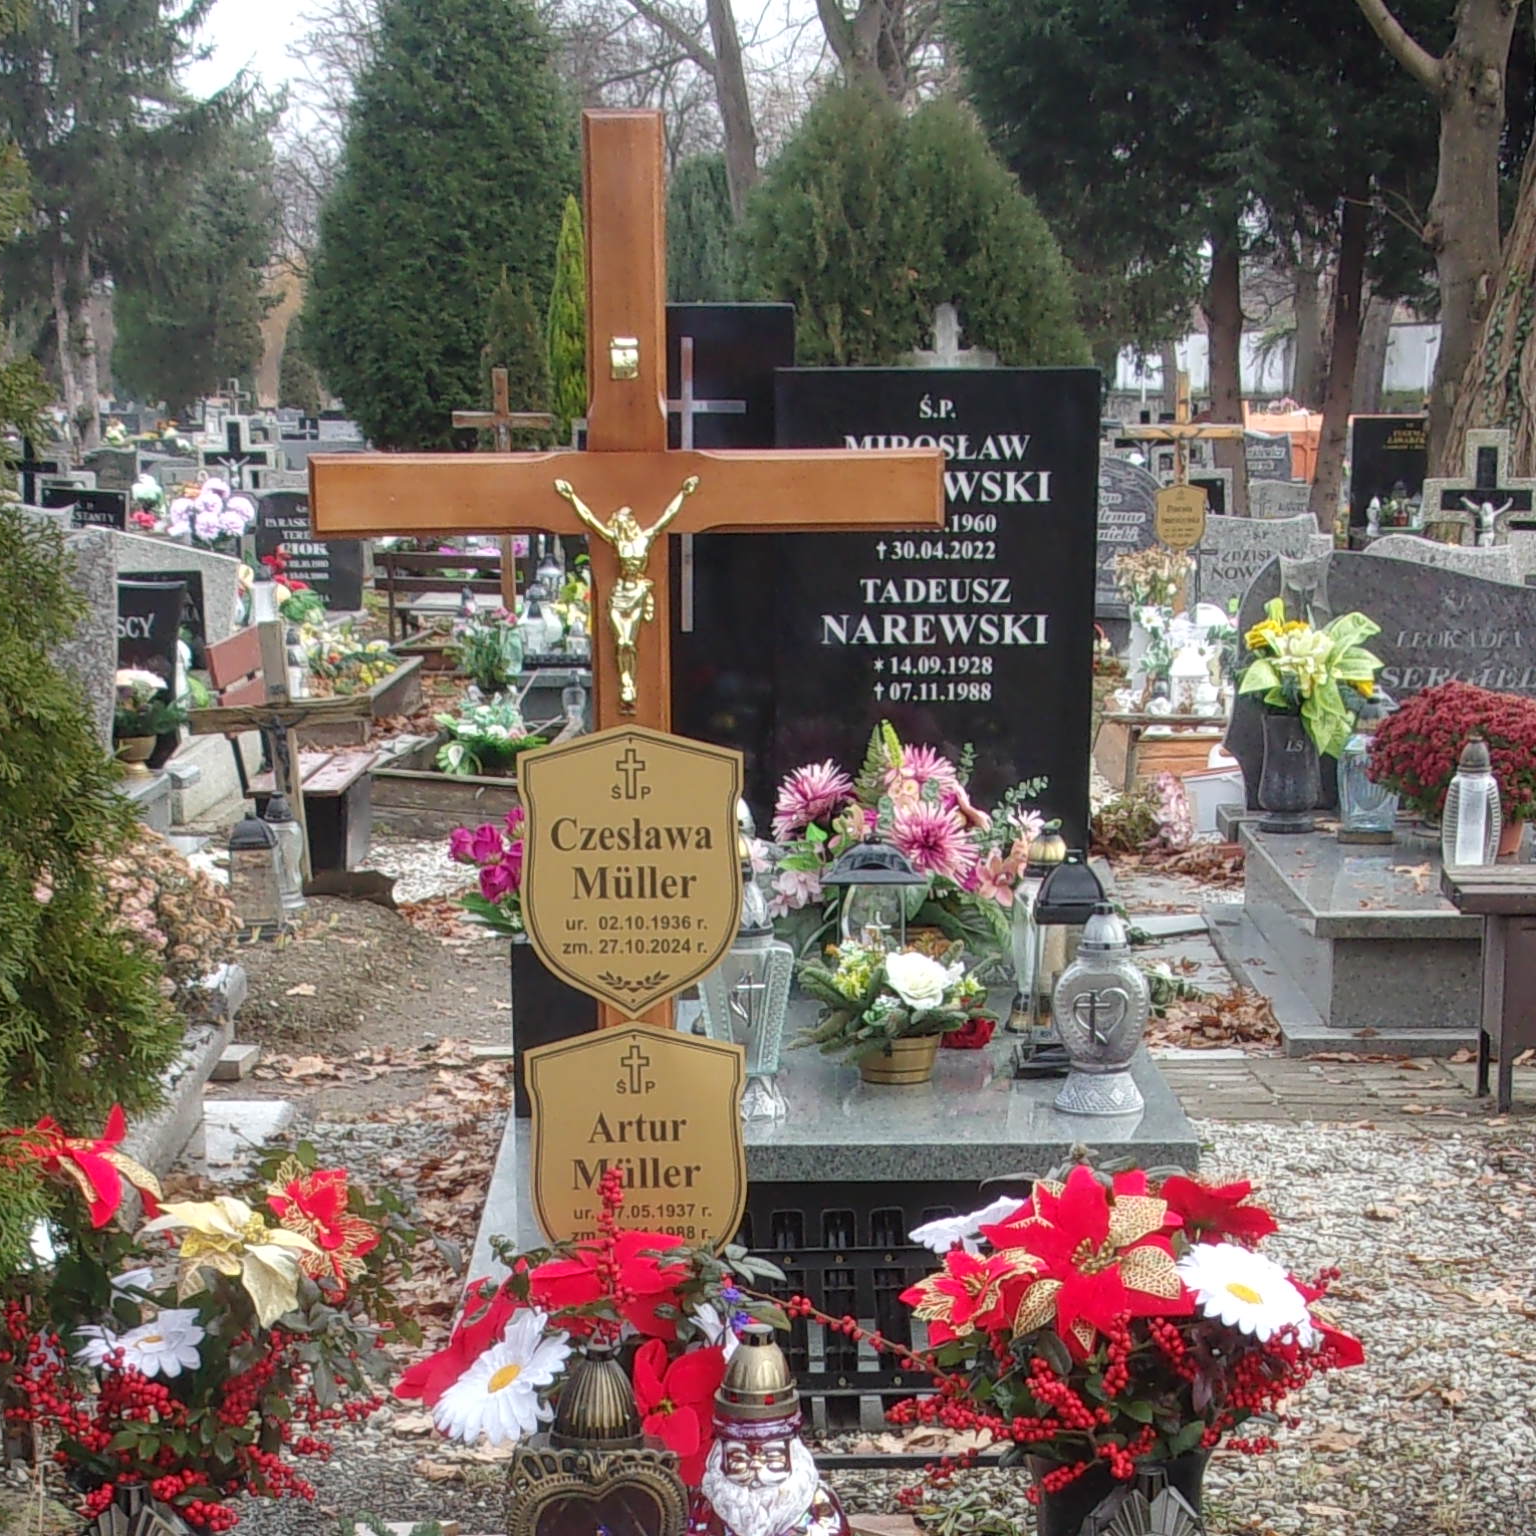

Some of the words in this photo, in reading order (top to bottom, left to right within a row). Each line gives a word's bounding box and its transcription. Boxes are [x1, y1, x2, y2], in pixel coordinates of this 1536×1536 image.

[919, 394, 956, 418] Ś.P.
[844, 435, 1030, 460] MIROSŁAW
[944, 471, 1051, 502] WSKI
[891, 541, 996, 559] 30.04.2022
[860, 578, 1011, 603] TADEUSZ
[116, 613, 155, 638] SCY
[821, 614, 1049, 644] NAREWSKI
[889, 656, 993, 674] 14.09.1928
[889, 683, 992, 700] 07.11.1988
[551, 817, 713, 852] Czesława
[572, 866, 697, 899] Müller
[565, 918, 588, 931] ur.
[598, 915, 691, 930] 02.10.1936
[696, 918, 708, 930] r.
[562, 942, 593, 955] zm.
[599, 938, 691, 954] 27.10.2024
[696, 941, 708, 953] r.
[588, 1112, 687, 1143] Artur
[572, 1157, 701, 1190] Müller
[573, 1208, 594, 1220] ur.
[610, 1204, 695, 1219] 7.05.1937
[701, 1206, 713, 1217] r.
